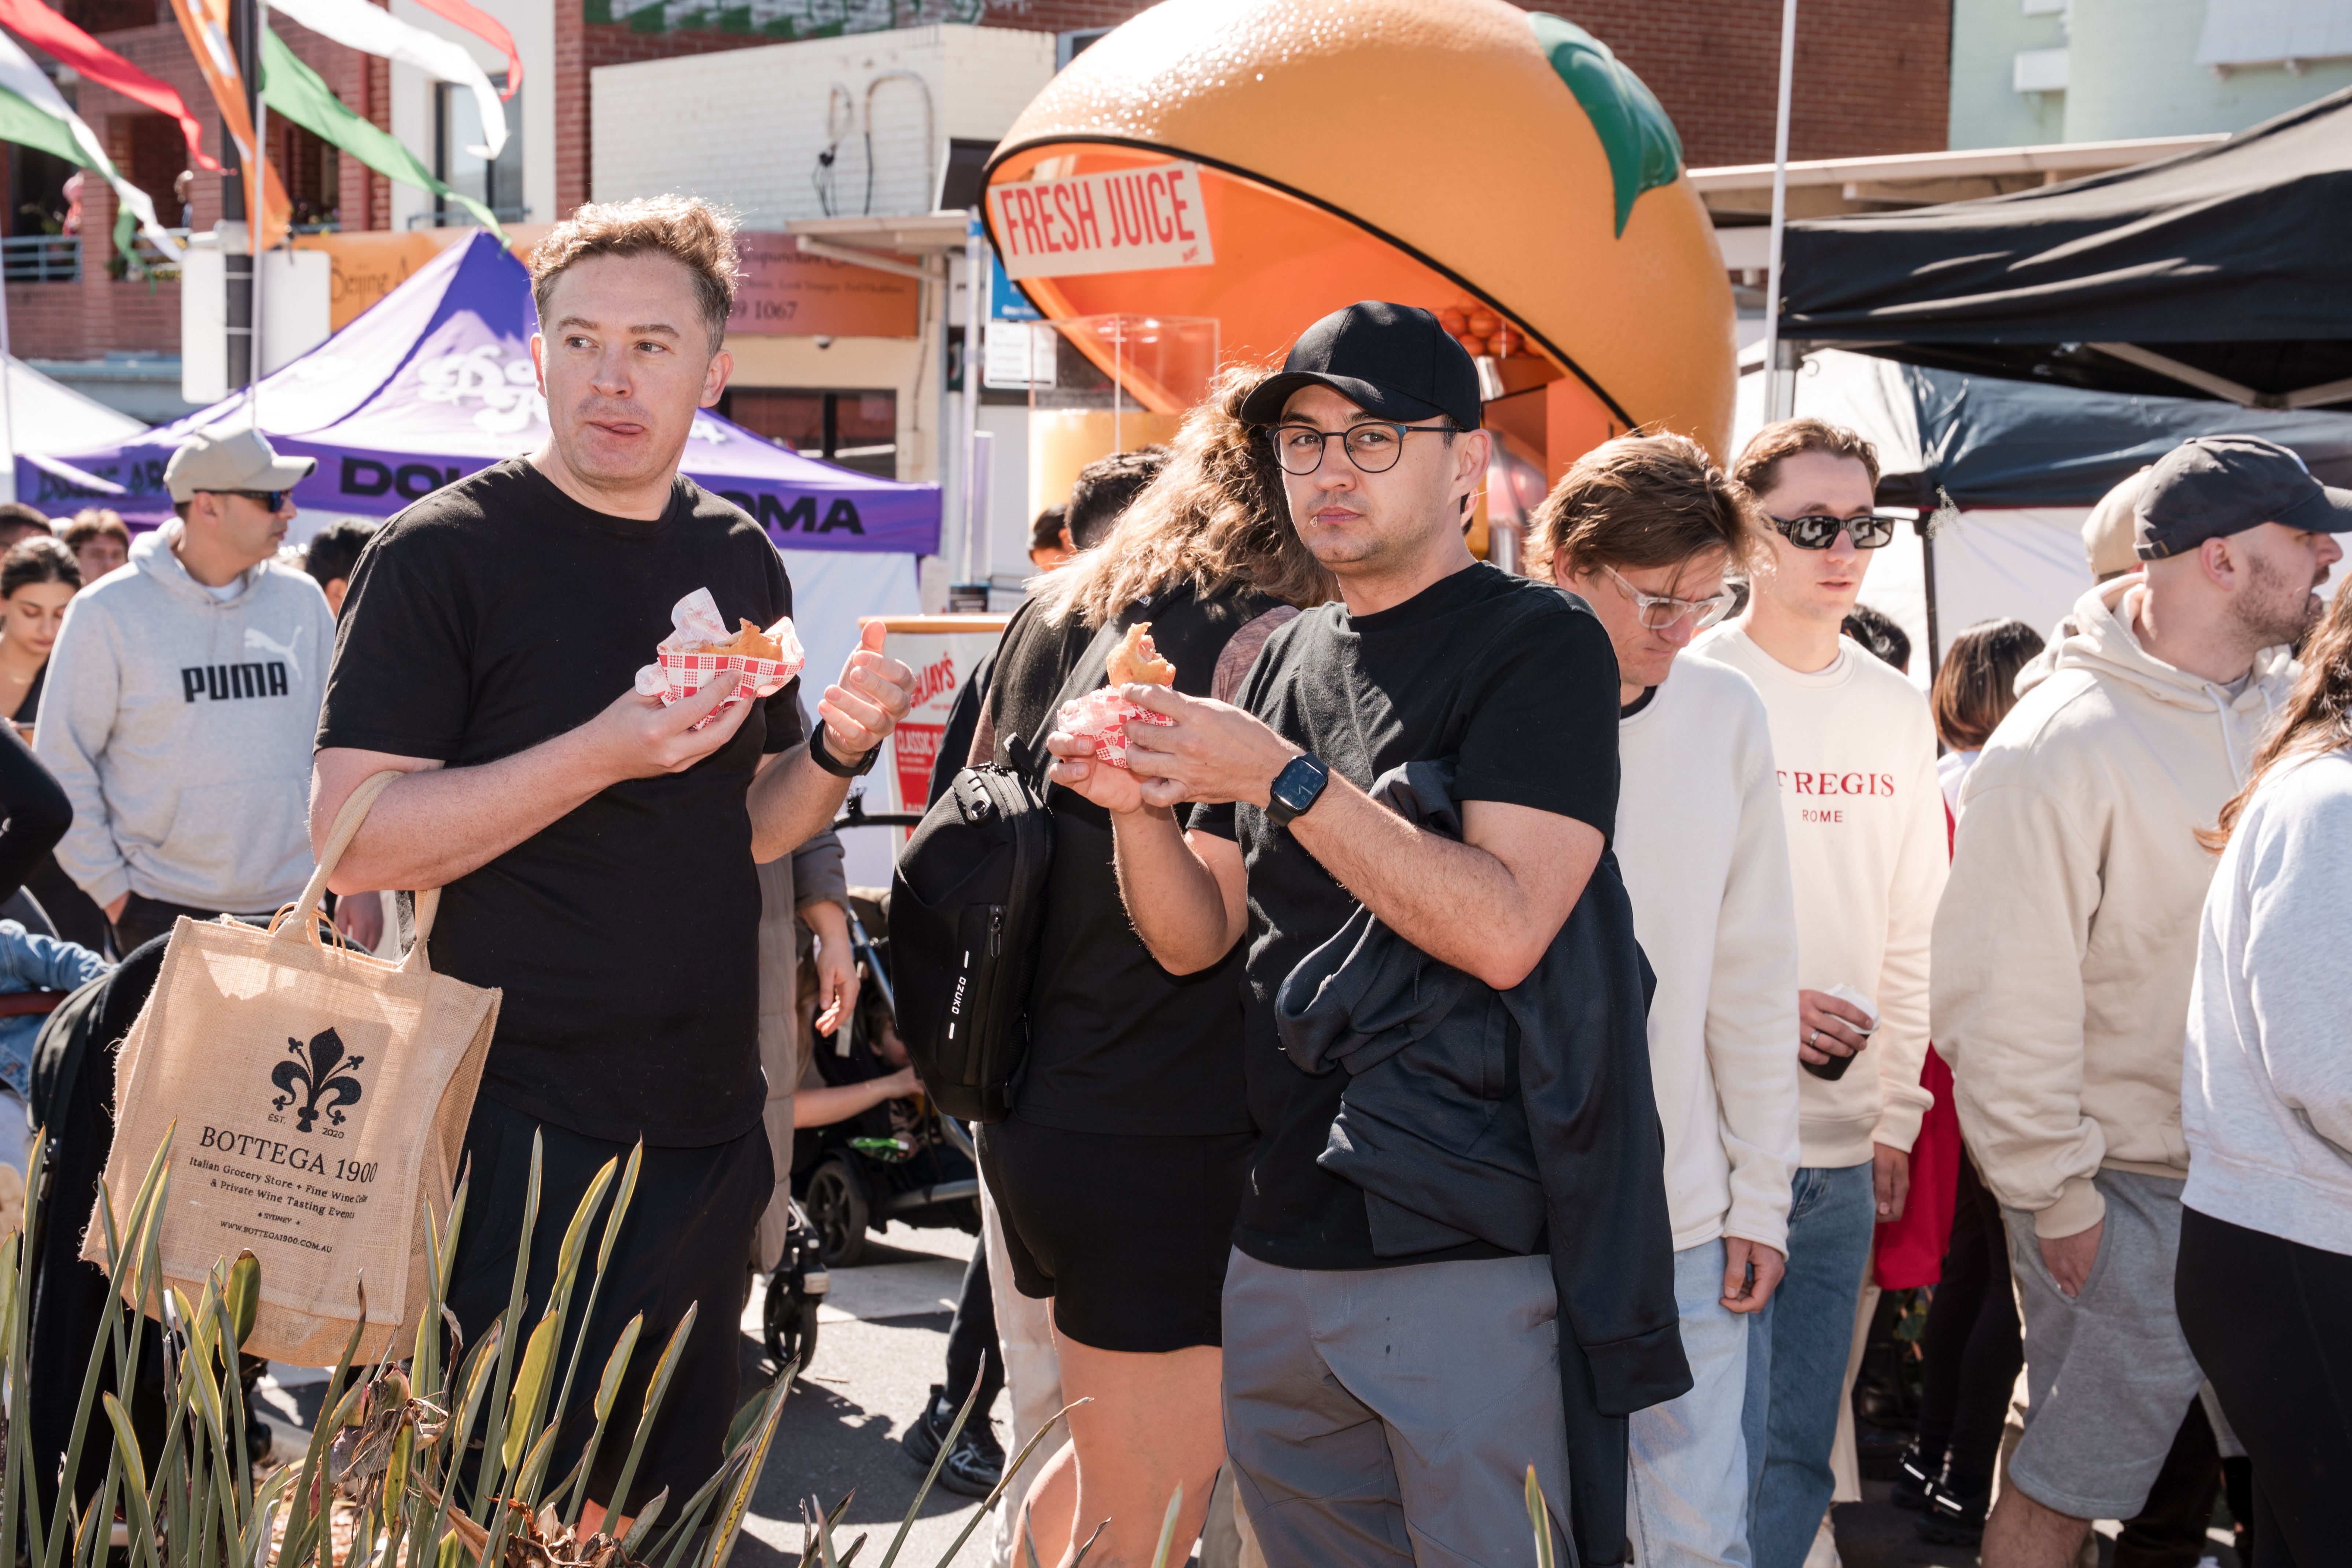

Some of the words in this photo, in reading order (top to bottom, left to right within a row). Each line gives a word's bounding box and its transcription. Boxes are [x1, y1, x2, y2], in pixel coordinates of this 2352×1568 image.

[1000, 180, 1102, 257] FRESH
[1104, 169, 1196, 247] JUICE
[181, 661, 289, 703] PUMA
[1793, 771, 1895, 797] REGIS
[1802, 809, 1844, 823] ROME
[952, 976, 967, 1015] OZUKO
[268, 1113, 287, 1125] EST.
[322, 1127, 345, 1139] 2020
[199, 1126, 326, 1175] BOTTEGA
[335, 1158, 378, 1183] 1900
[189, 1157, 220, 1172] Italian
[222, 1165, 262, 1183] Grocery
[264, 1175, 293, 1189] Store
[305, 1184, 328, 1197] Fine
[331, 1191, 354, 1203] Wine
[210, 1178, 217, 1188] &
[220, 1180, 254, 1196] Private
[257, 1189, 283, 1203] Wine
[287, 1196, 326, 1216] Tasting
[328, 1207, 355, 1219] Events
[221, 1220, 332, 1253] WWW.BOTTEGA1900.COM.AU
[263, 1212, 292, 1223] SYDNEY
